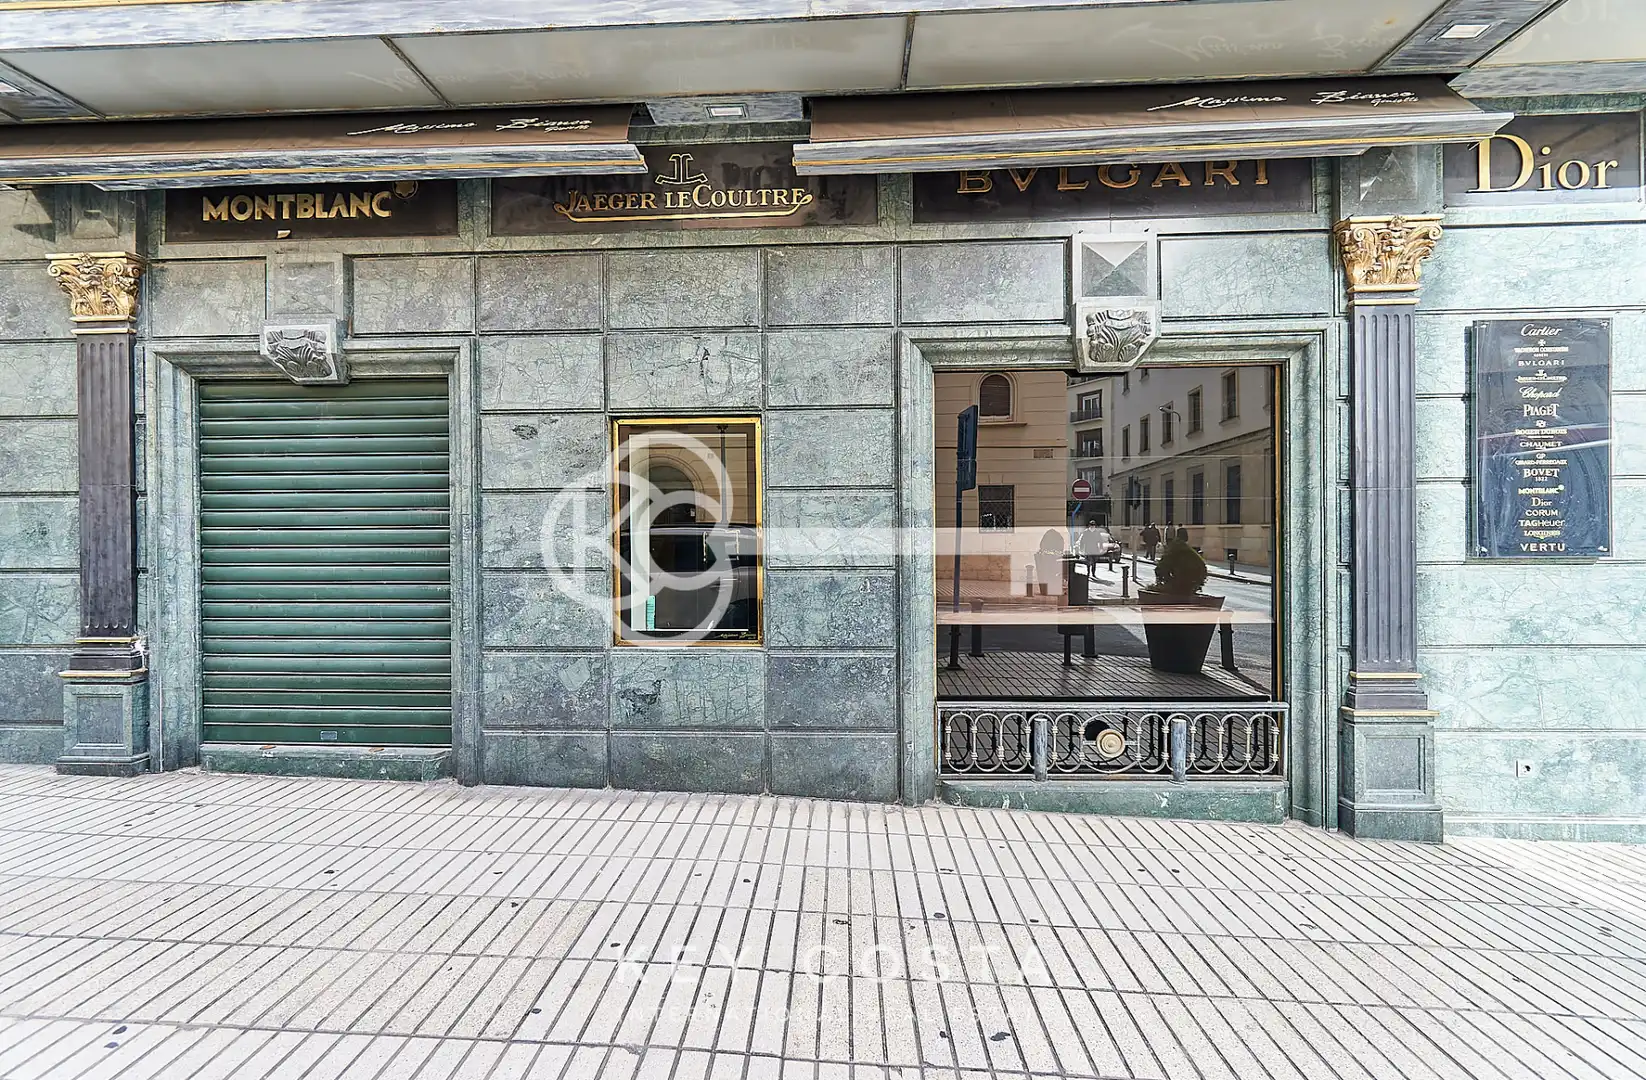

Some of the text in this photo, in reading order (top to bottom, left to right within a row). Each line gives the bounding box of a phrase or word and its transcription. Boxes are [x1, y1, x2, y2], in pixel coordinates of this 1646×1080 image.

[1467, 134, 1619, 193] Dior
[956, 159, 1269, 194] BVLGARI
[202, 190, 393, 222] MONTBLANC
[554, 188, 658, 215] JAEGER
[1520, 323, 1563, 337] Cartier
[1523, 403, 1560, 417] PIAGET
[1523, 468, 1560, 478] BOVET
[1531, 496, 1553, 507] Dior
[1525, 509, 1559, 517] CORUM
[1520, 543, 1566, 552] VERTU
